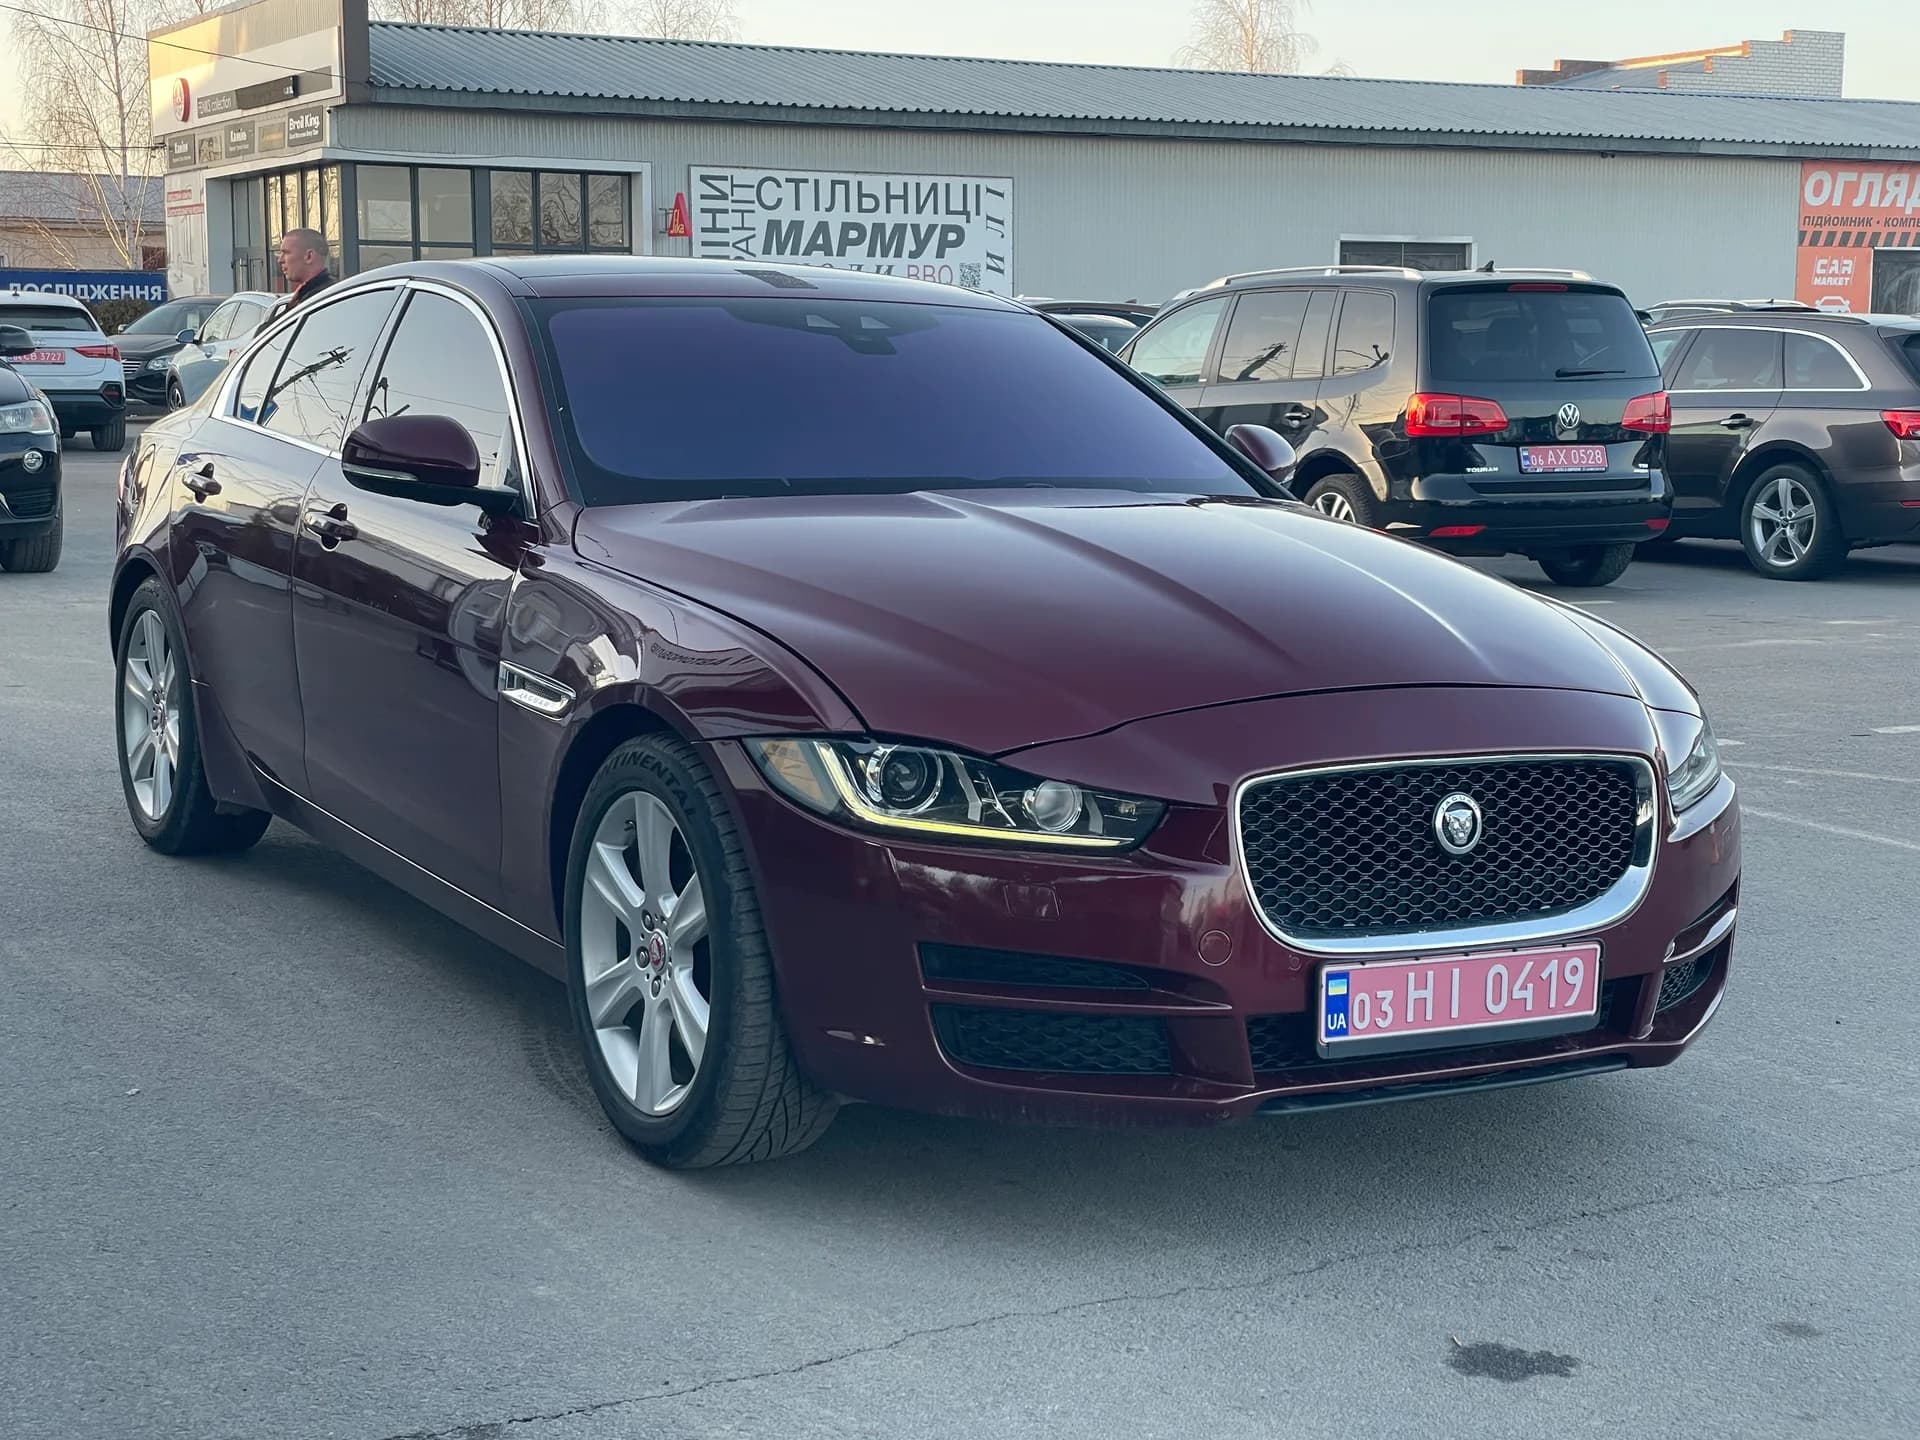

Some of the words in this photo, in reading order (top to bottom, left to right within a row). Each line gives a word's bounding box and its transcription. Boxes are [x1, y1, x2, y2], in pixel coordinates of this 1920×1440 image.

[289, 115, 304, 130] Broil
[755, 175, 982, 223] СТІЛЬНИЦІ
[700, 174, 730, 259] ІНИ
[731, 174, 757, 260] АНІТ
[1802, 214, 1874, 228] ПІДЙОМНИК
[761, 219, 966, 259] МАРМУР
[1815, 259, 1854, 274] CAR
[1813, 276, 1851, 286] MARKET
[40, 352, 62, 361] 3727
[1531, 455, 1544, 466] 06
[1548, 449, 1567, 465] AX
[1571, 449, 1603, 465] 0528
[591, 751, 697, 817] NTINENTAL
[1327, 1013, 1347, 1030] UA
[1352, 990, 1394, 1030] 03
[1406, 967, 1460, 1023] HI
[1485, 957, 1584, 1014] 0419
